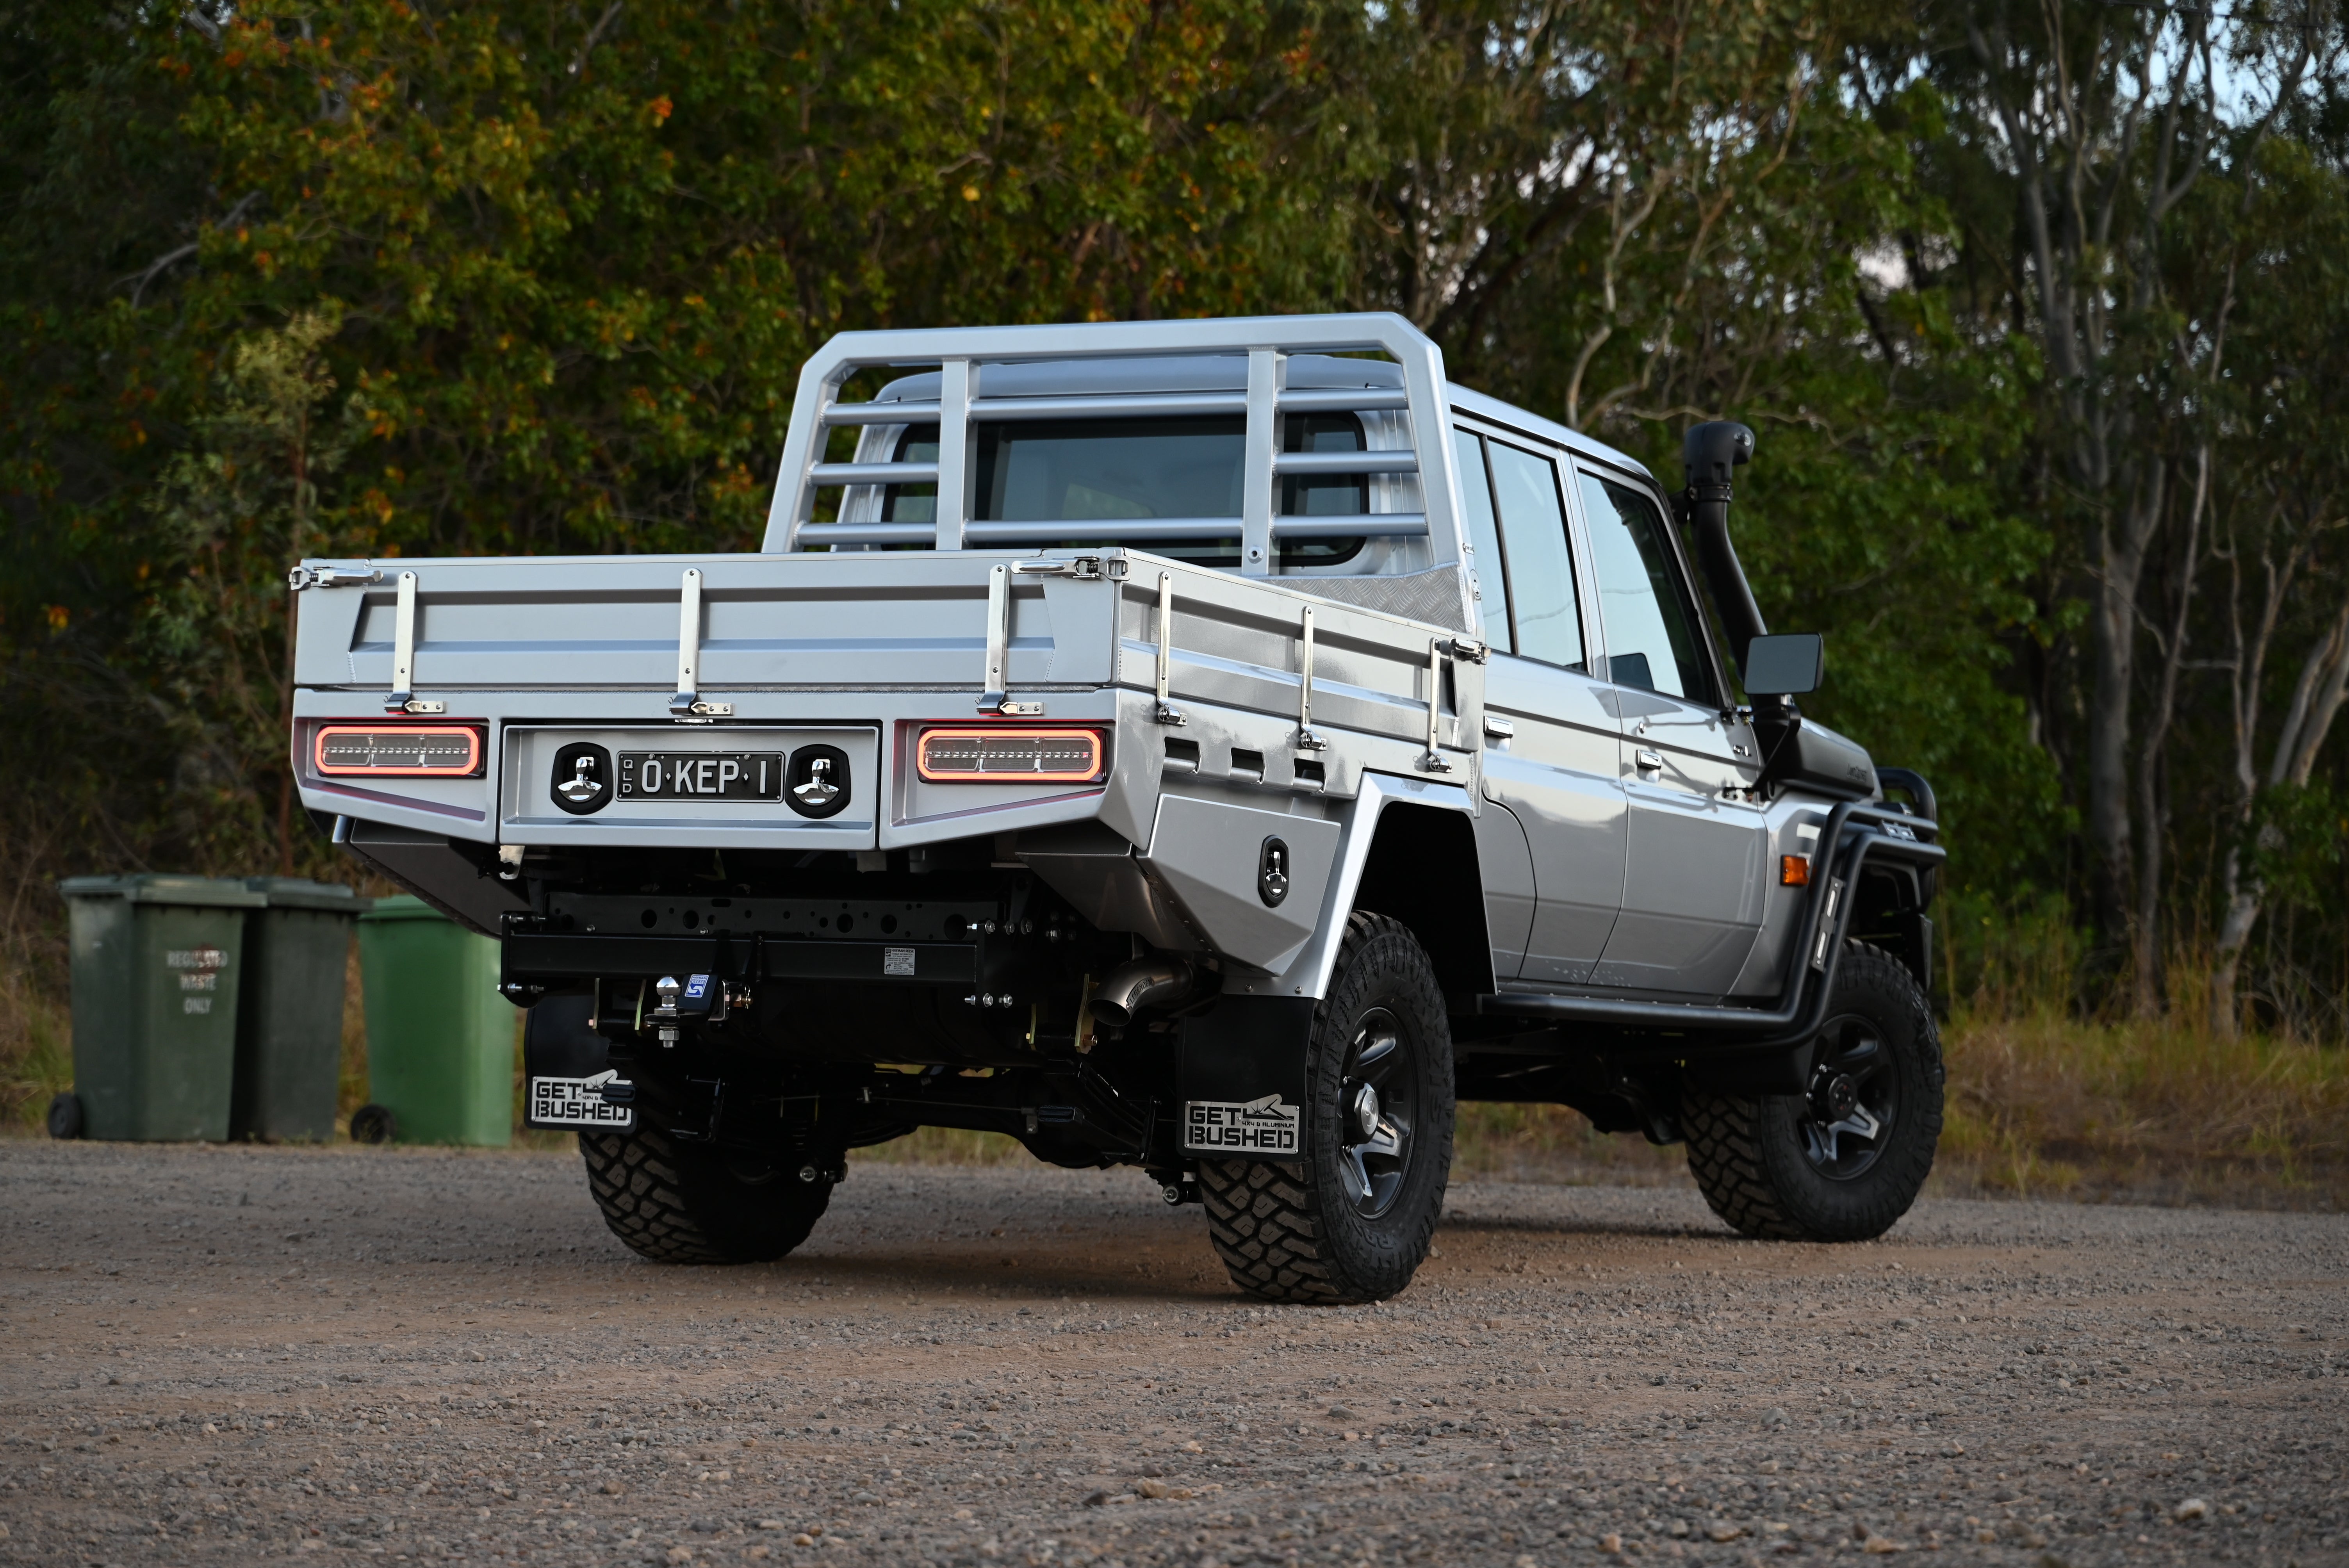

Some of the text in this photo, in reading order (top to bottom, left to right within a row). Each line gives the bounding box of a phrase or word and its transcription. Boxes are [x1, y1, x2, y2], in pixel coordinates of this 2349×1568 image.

[623, 759, 633, 793] QLD
[675, 760, 739, 793] KEP
[184, 997, 213, 1014] ONLY
[536, 1081, 582, 1099] GET
[536, 1100, 628, 1121] BUSHED
[1189, 1106, 1241, 1125] GET
[1189, 1126, 1294, 1149] BUSHED
